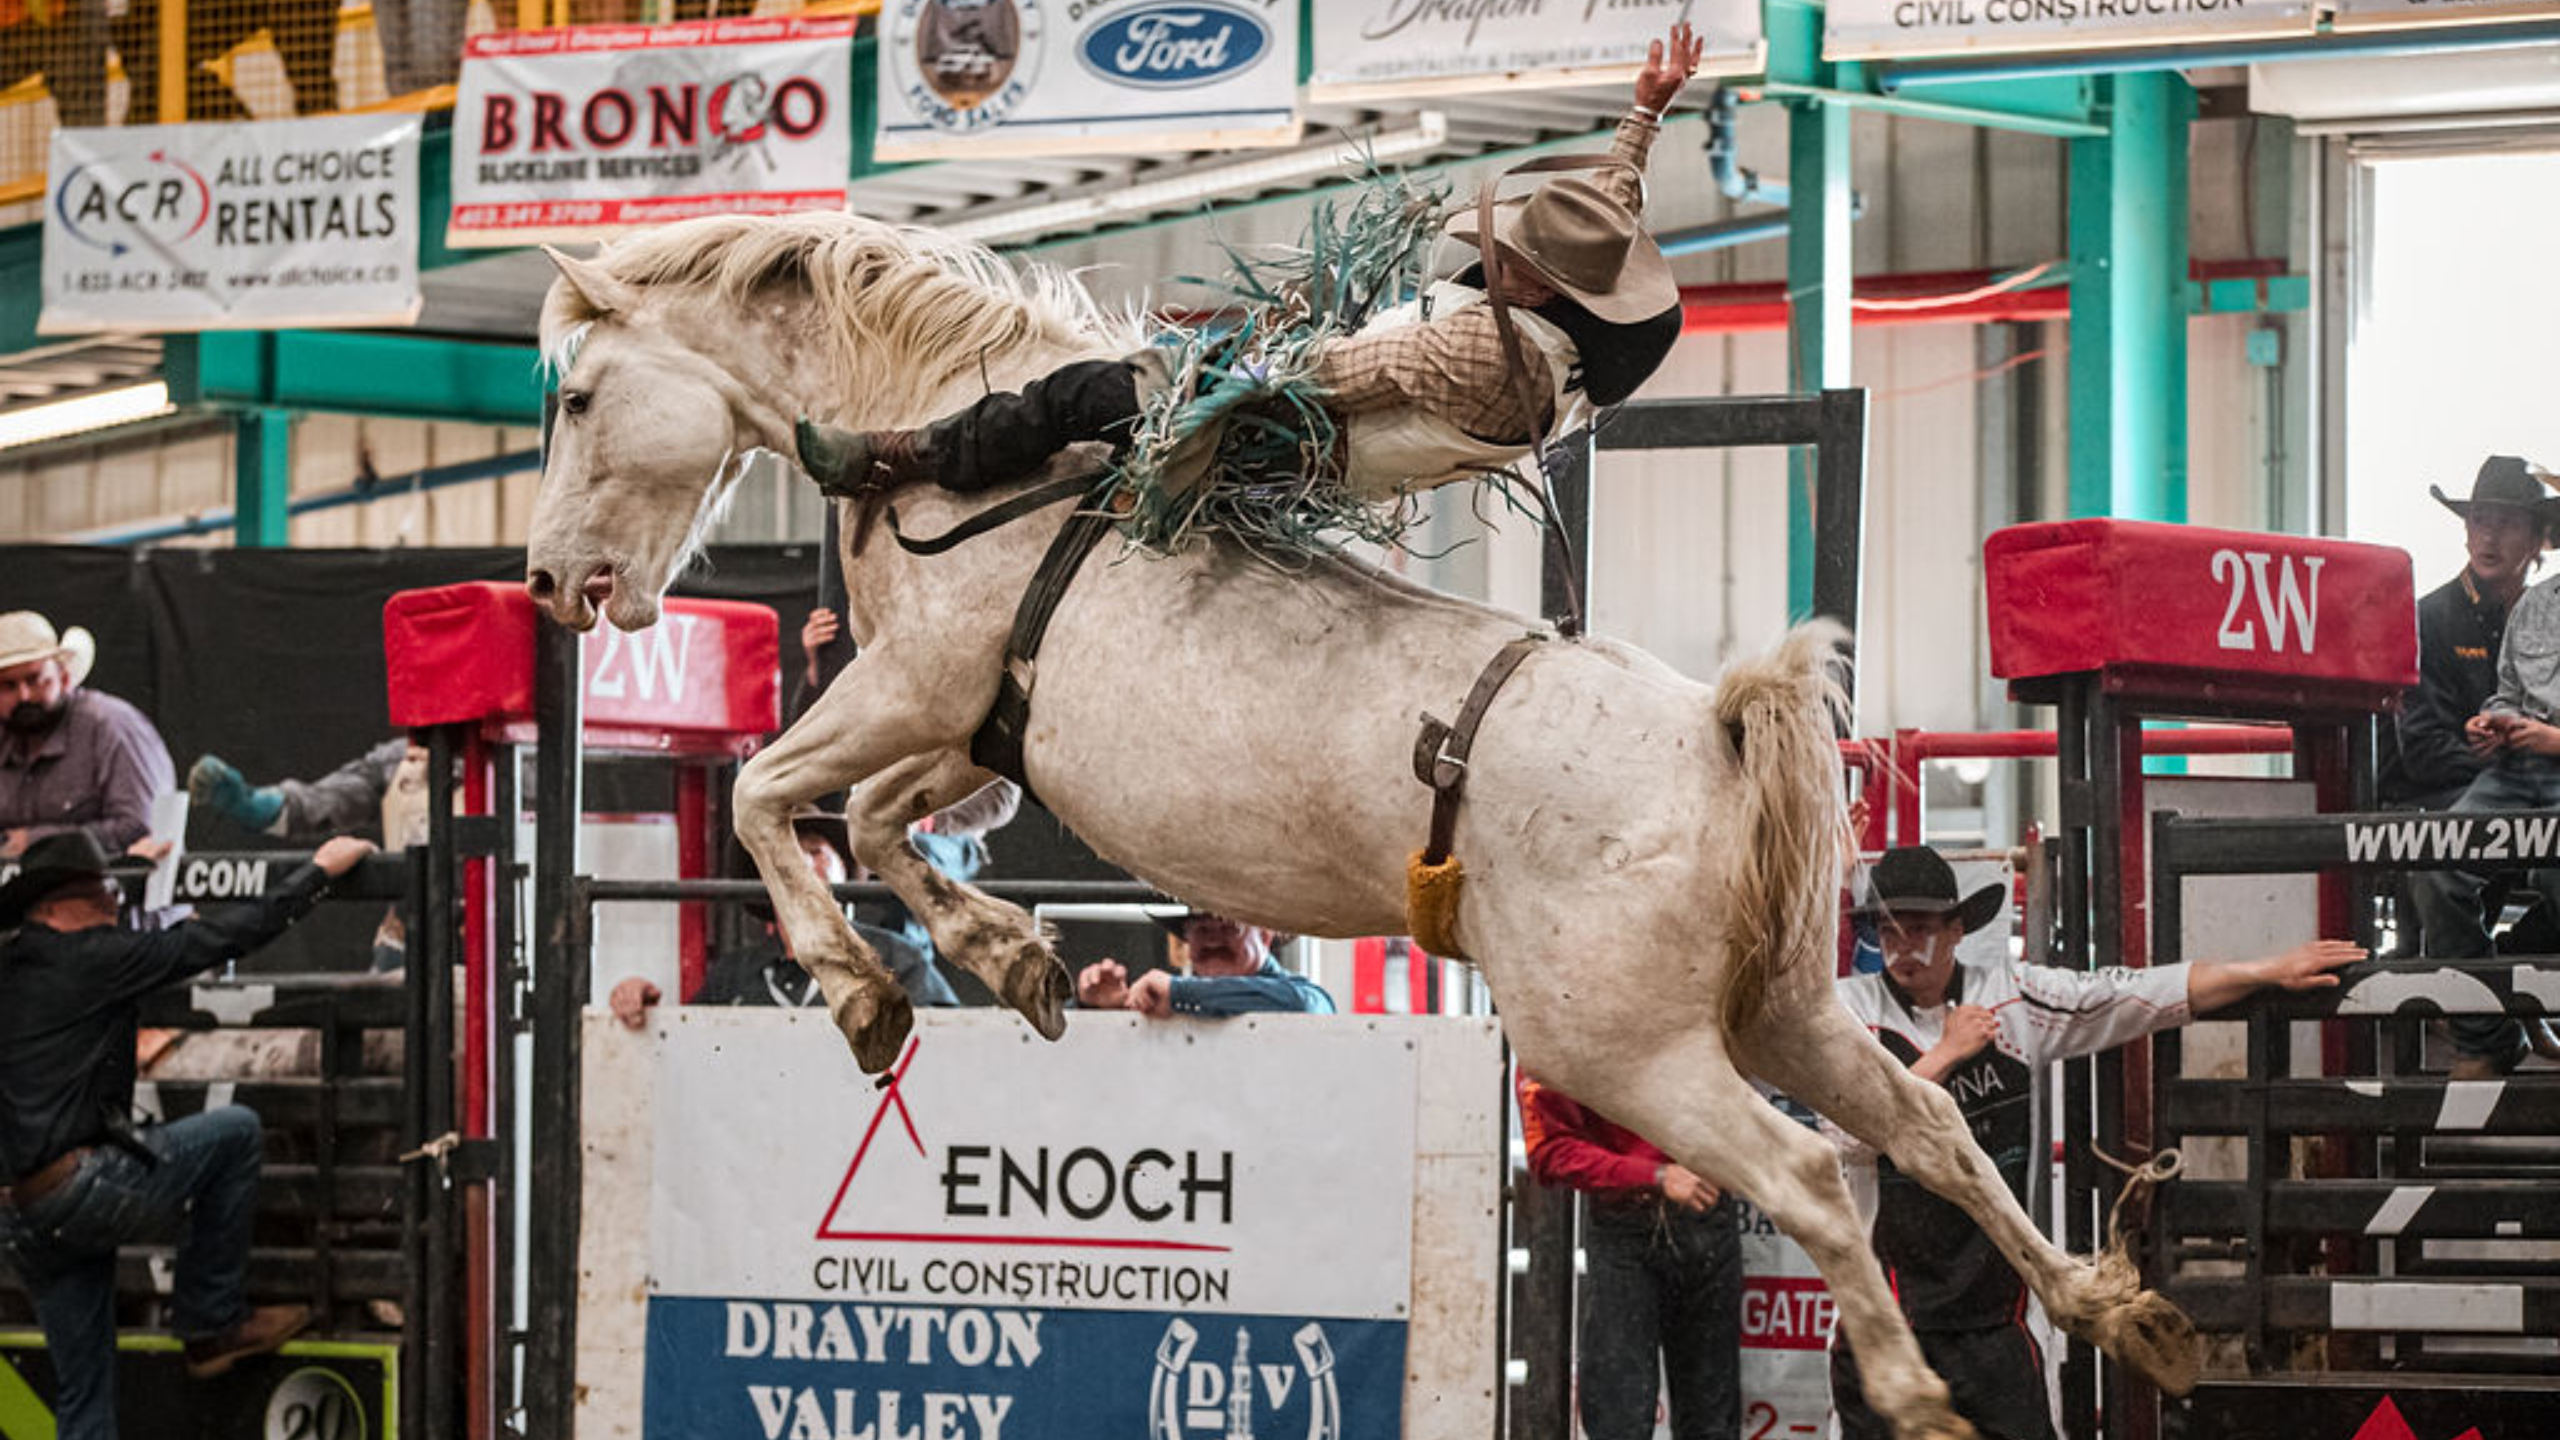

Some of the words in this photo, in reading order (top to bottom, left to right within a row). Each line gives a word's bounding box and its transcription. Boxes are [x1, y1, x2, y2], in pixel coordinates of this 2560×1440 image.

[1894, 0, 1975, 28] CIVIL
[1116, 13, 1234, 72] Ford
[480, 74, 828, 156] BRONCO
[217, 157, 263, 188] ALL
[273, 147, 396, 186] CHOICE
[76, 179, 185, 223] ACR
[216, 192, 397, 248] RENTALS
[2212, 549, 2326, 655] 2W
[2346, 817, 2560, 862] WWW.2W
[941, 1146, 1233, 1225] ENOCH
[814, 1256, 909, 1292] CIVIL
[923, 1259, 1230, 1303] CONSTRUCTION
[725, 1301, 1043, 1367] DRAYTON
[747, 1386, 1014, 1440] VALLEY
